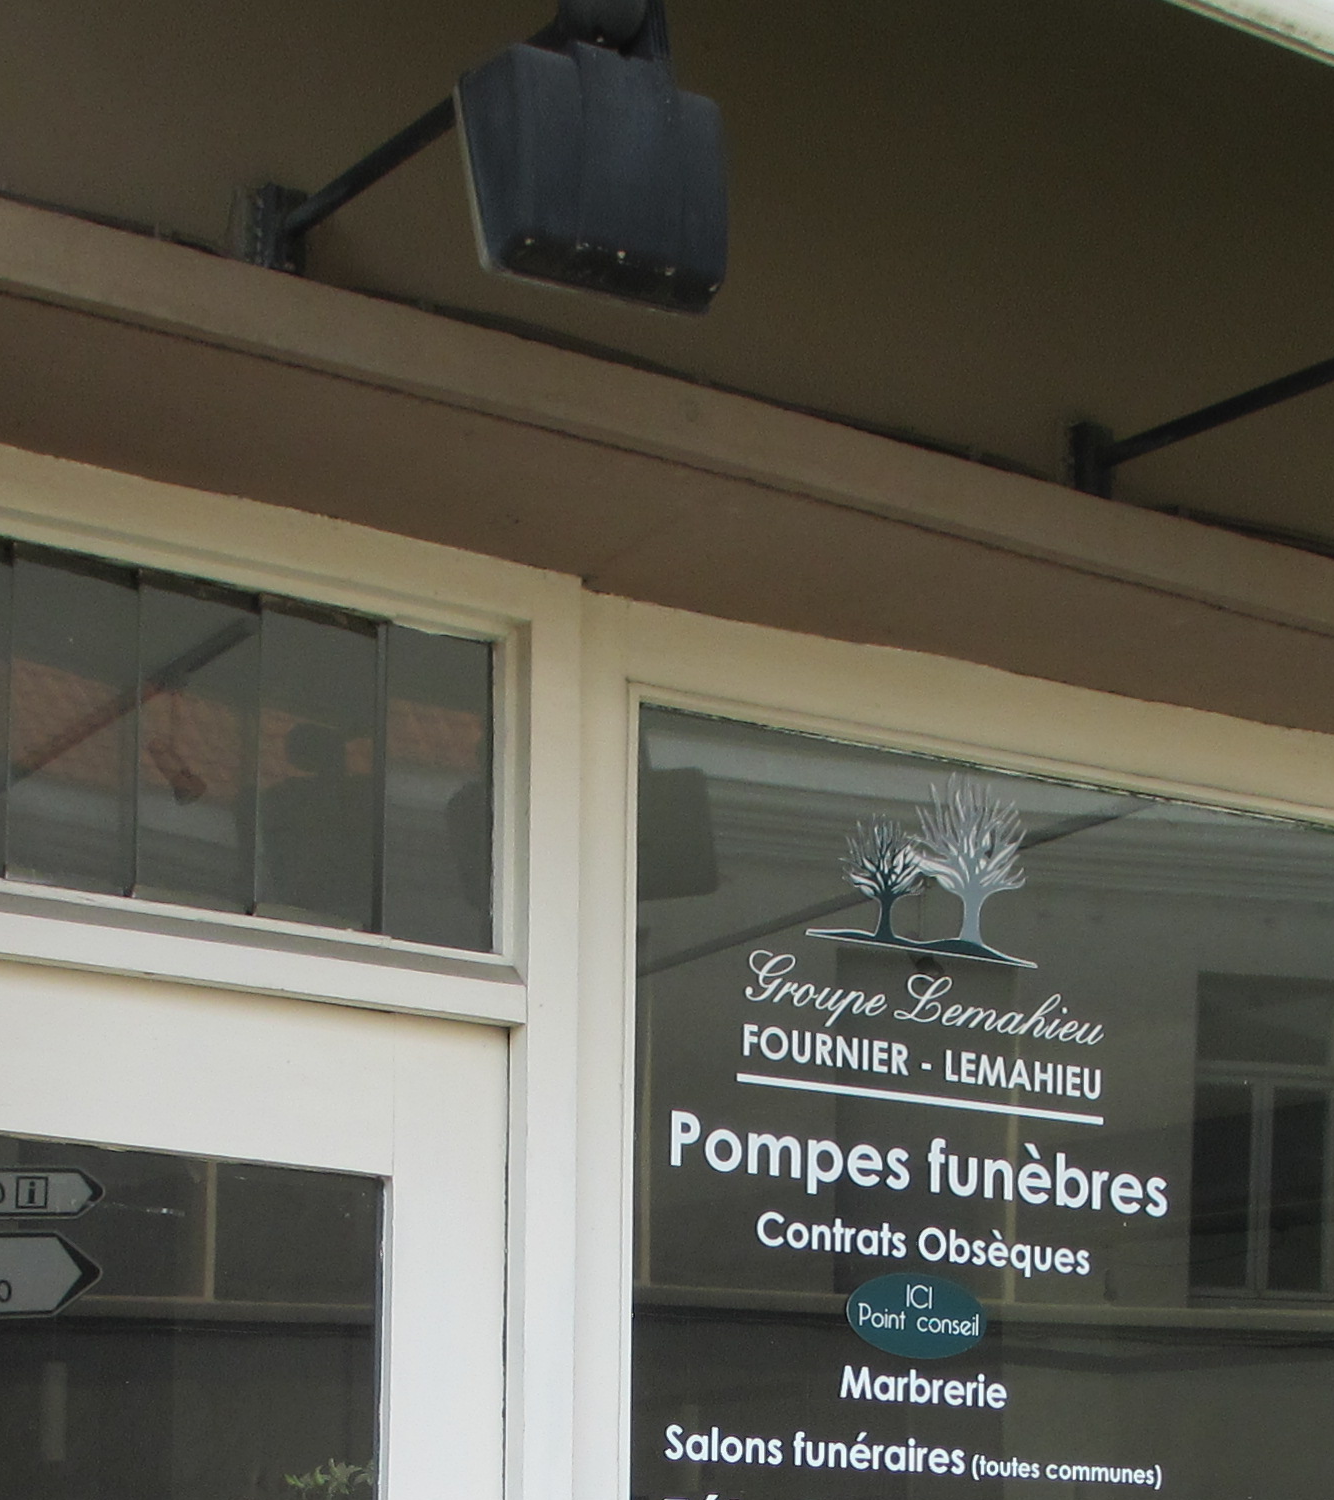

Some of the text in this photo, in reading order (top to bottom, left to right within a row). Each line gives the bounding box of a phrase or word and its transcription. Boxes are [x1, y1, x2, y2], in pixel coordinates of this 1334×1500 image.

[744, 949, 1105, 1046] Groupe Lemahieu
[742, 1023, 909, 1076] FOURNIER
[944, 1050, 1102, 1100] LEMAHIEU
[669, 1110, 1168, 1217] Pompes funèbres
[756, 1211, 1091, 1277] Contrats Obsèques
[858, 1303, 980, 1338] Point conseil
[905, 1284, 933, 1309] ICI
[840, 1365, 1008, 1409] Marbrerie
[664, 1425, 1162, 1490] Salons funéraires (toutes communes)
